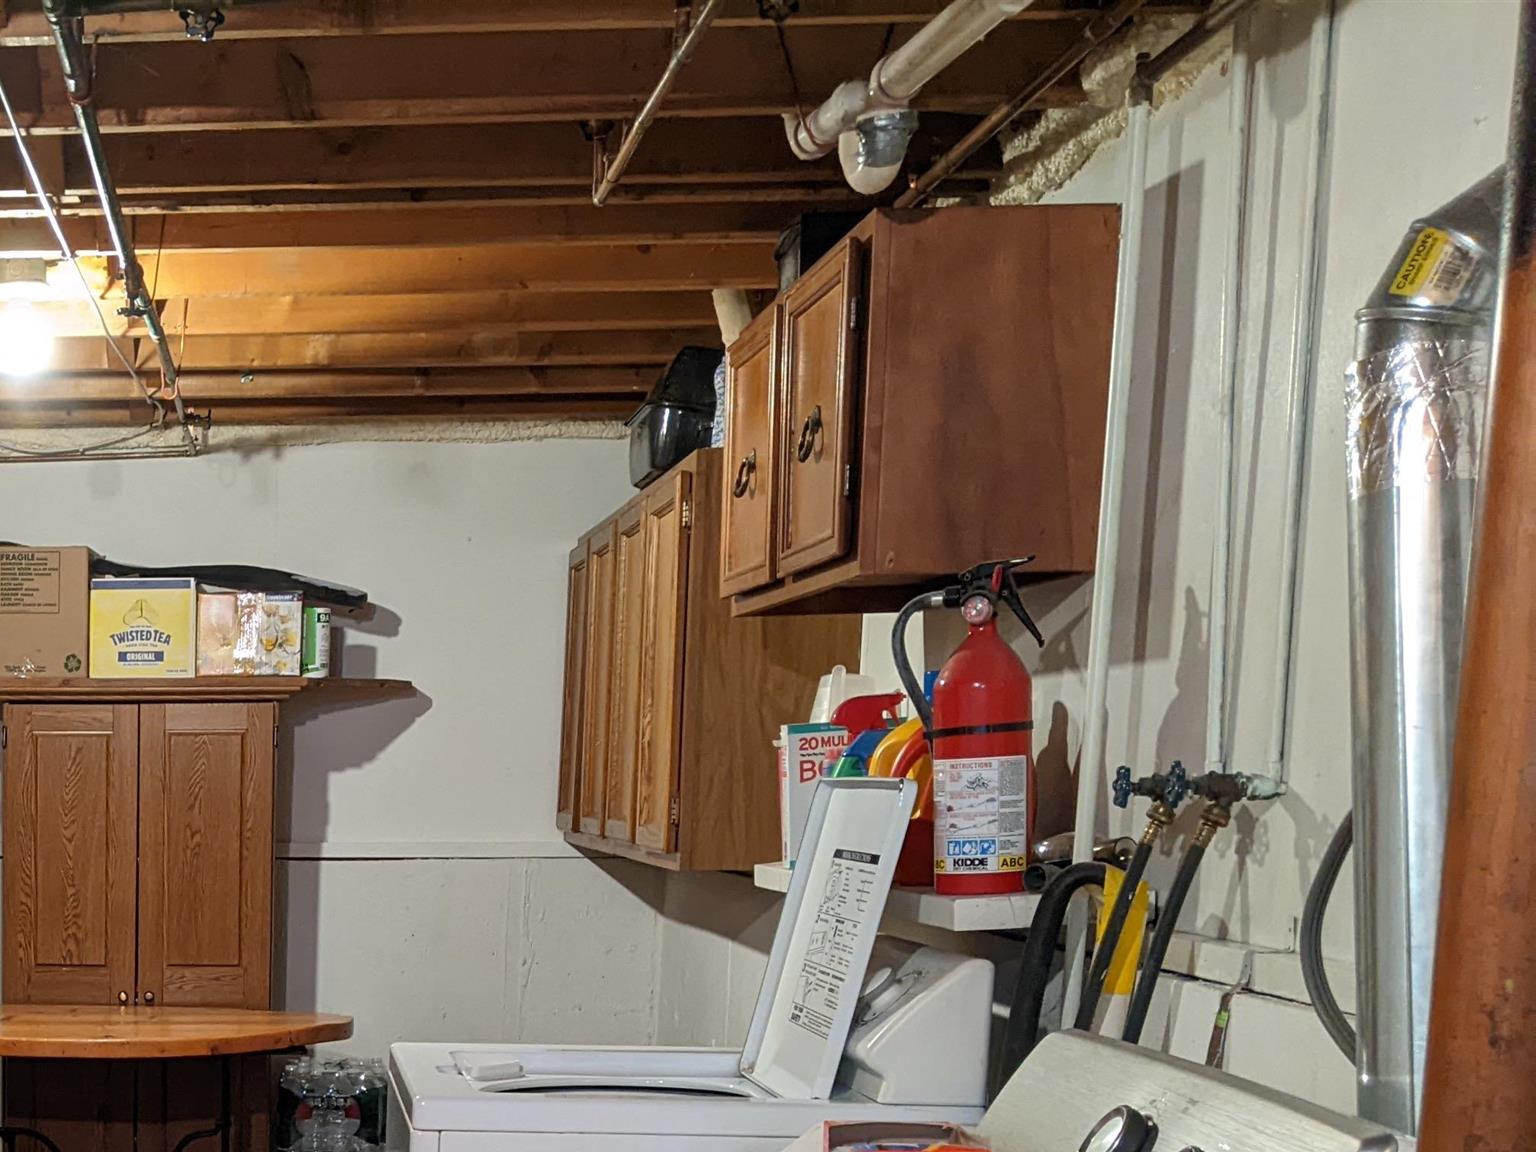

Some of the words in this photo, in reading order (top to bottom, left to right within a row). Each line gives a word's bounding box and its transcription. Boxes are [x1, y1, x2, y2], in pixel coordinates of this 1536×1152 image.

[0, 553, 35, 561] FRAGILE
[109, 629, 152, 646] TWISTED
[153, 629, 172, 646] TEA
[126, 652, 156, 661] ORIGINAL
[798, 736, 819, 751] 20
[949, 761, 993, 770] INSTRUCTIONS
[953, 857, 989, 868] KIDDE
[1000, 856, 1025, 868] ABC
